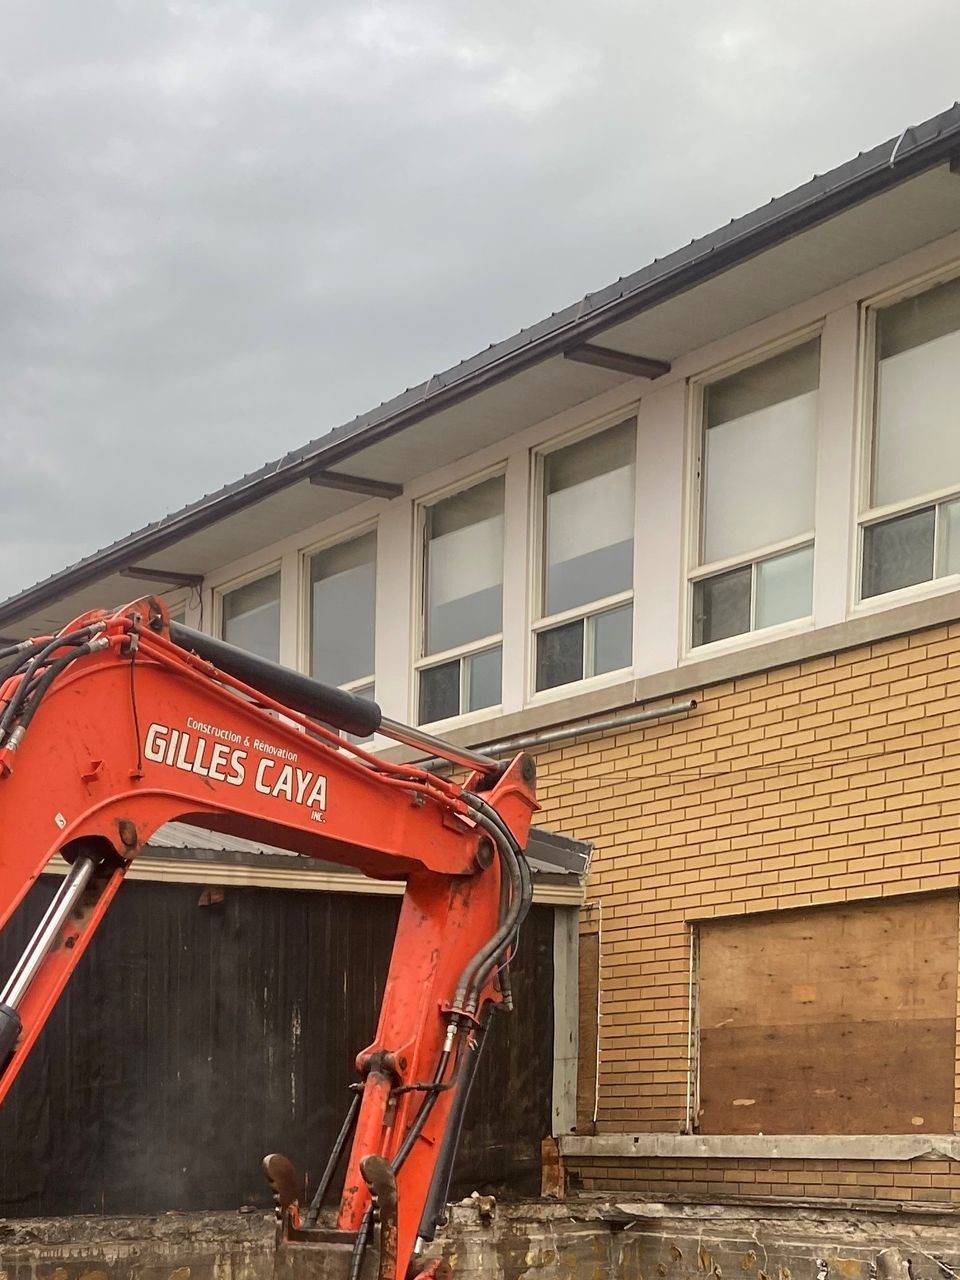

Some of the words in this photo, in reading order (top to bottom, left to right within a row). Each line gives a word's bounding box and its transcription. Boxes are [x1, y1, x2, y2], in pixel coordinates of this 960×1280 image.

[144, 722, 248, 786] GILLES
[254, 757, 327, 811] CAYA
[187, 717, 241, 744] Construction
[243, 736, 250, 747] &
[253, 738, 298, 762] Rénovation
